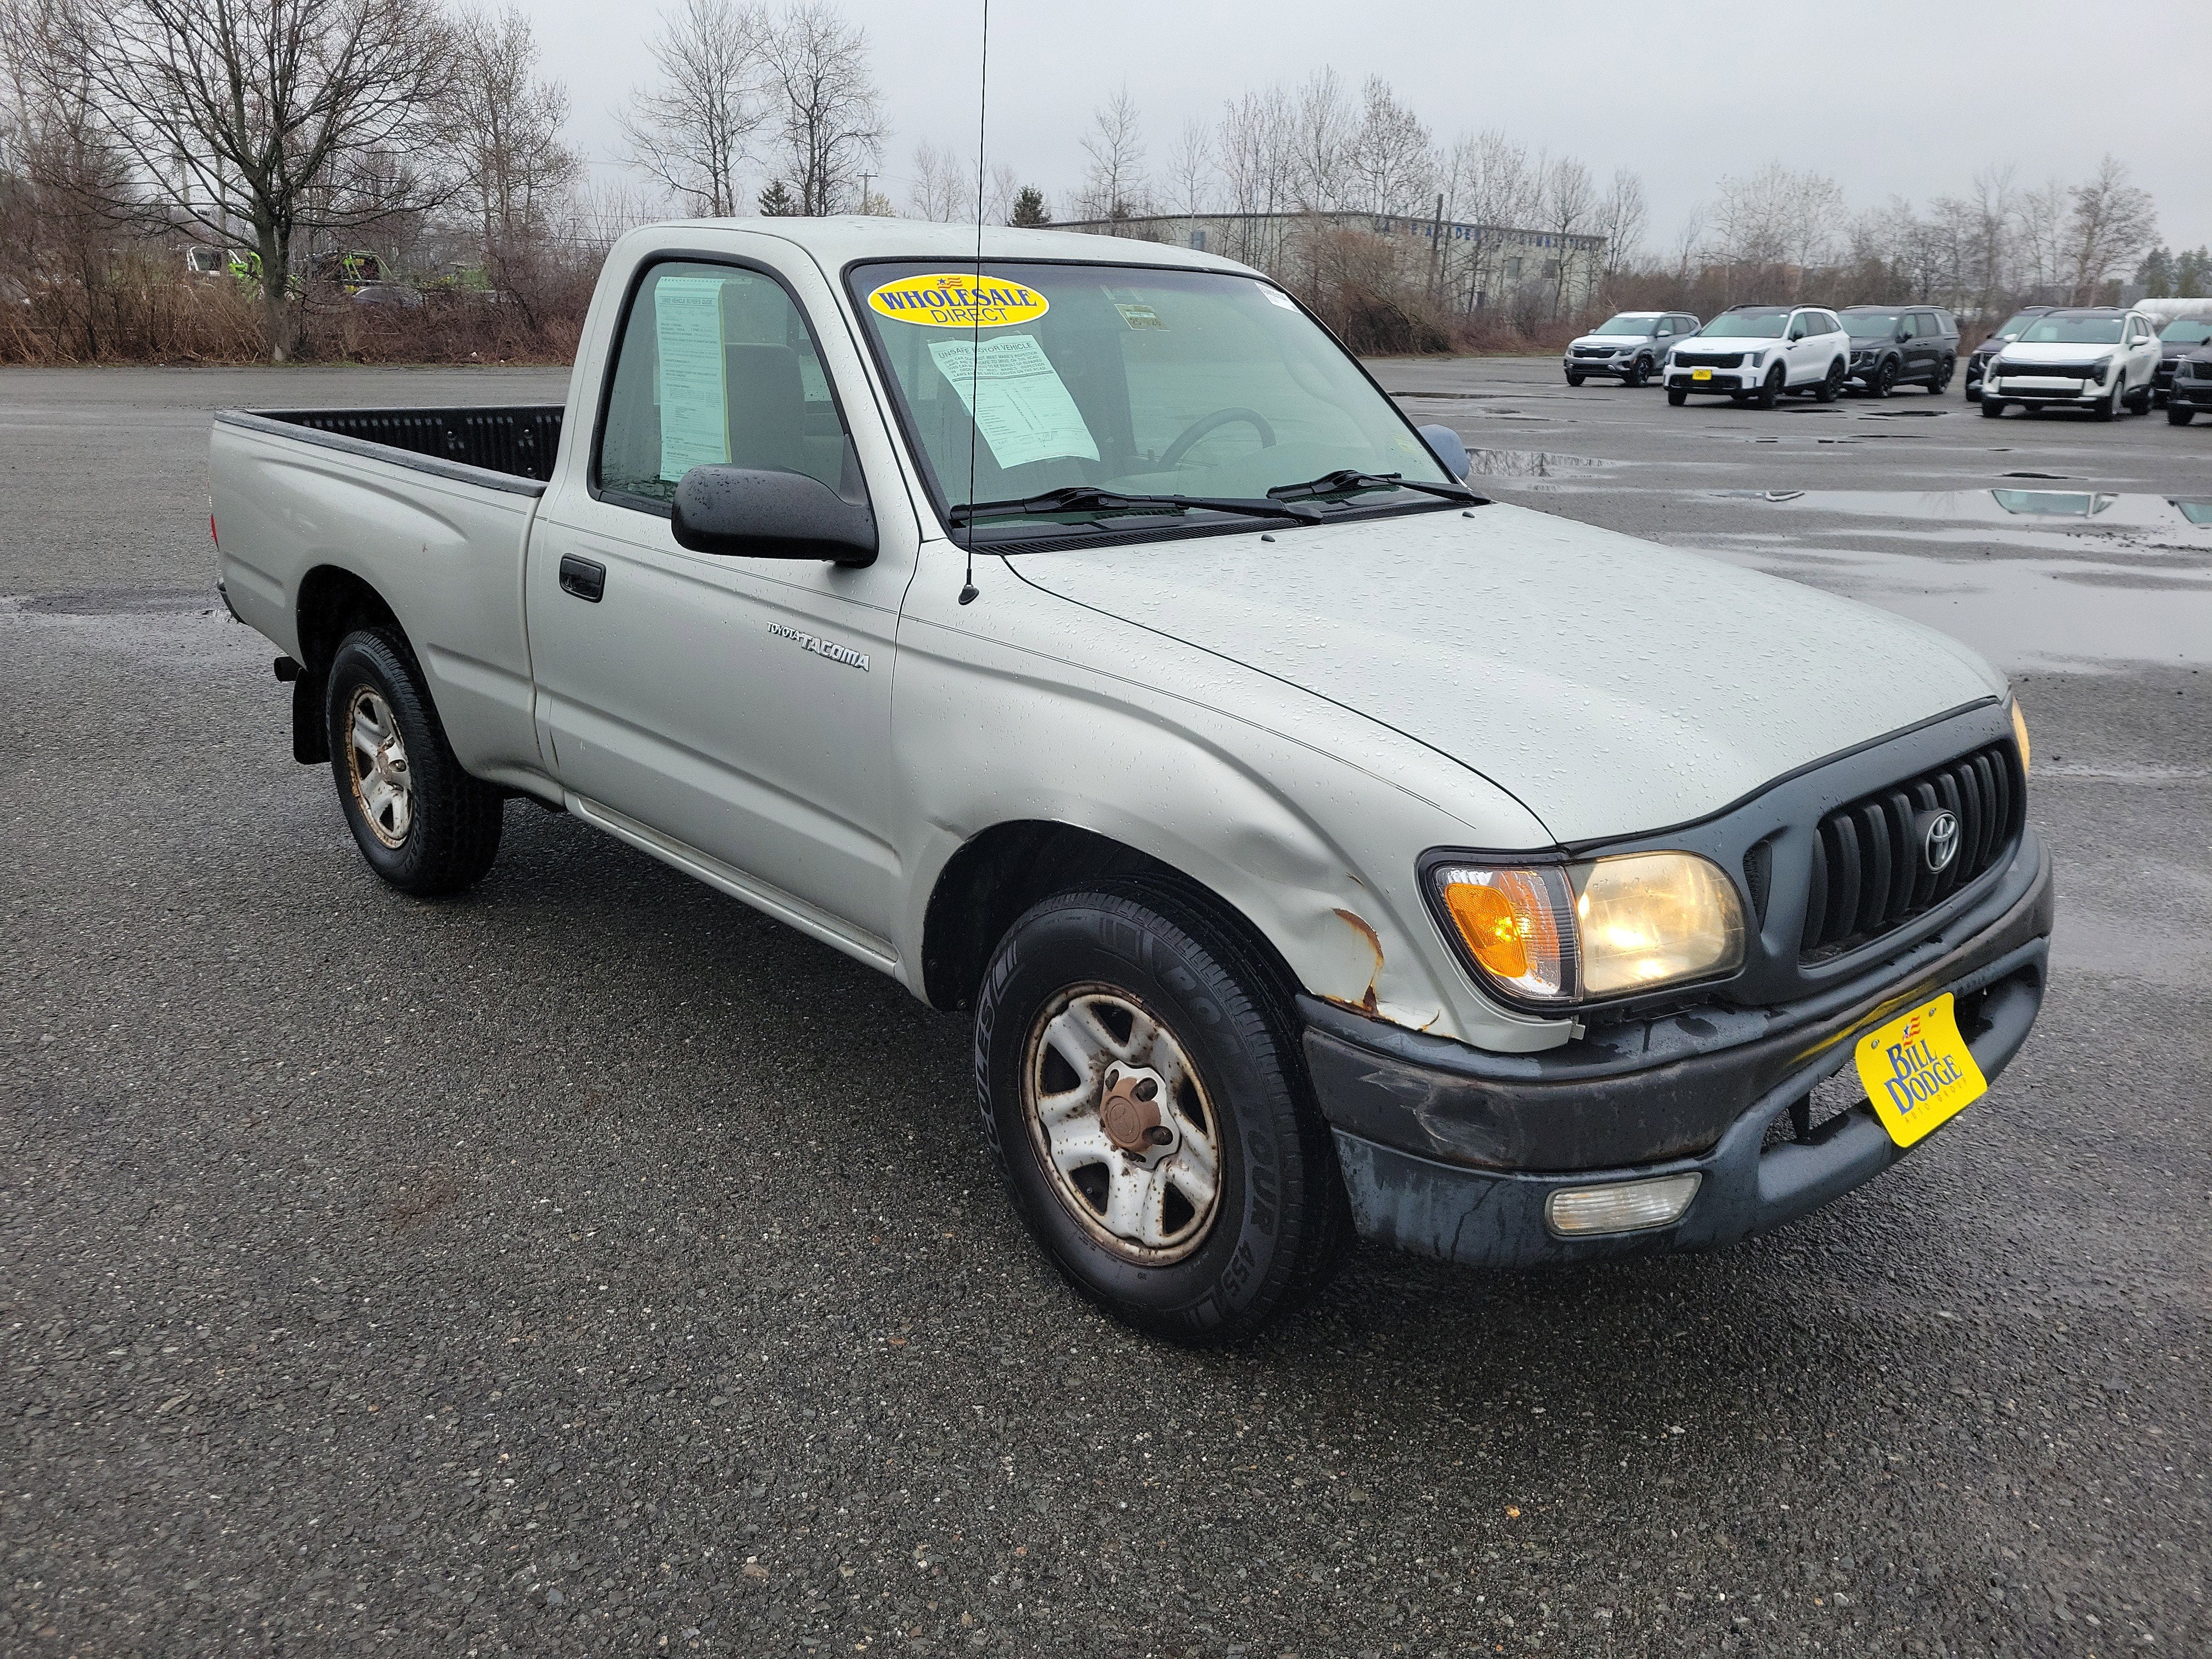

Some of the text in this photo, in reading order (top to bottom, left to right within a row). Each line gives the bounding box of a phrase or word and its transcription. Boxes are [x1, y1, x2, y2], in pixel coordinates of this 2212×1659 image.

[877, 289, 1037, 310] WHOLESALE
[930, 307, 1008, 323] DIRECT
[939, 348, 971, 358] UNSAFE
[1000, 342, 1033, 351] VEHICLE
[767, 621, 871, 672] TOYOTA TACOMA
[1886, 1038, 1938, 1079] BILL
[1884, 1054, 1963, 1116] DODGE
[1906, 1078, 1967, 1124] AUTO GROUP
